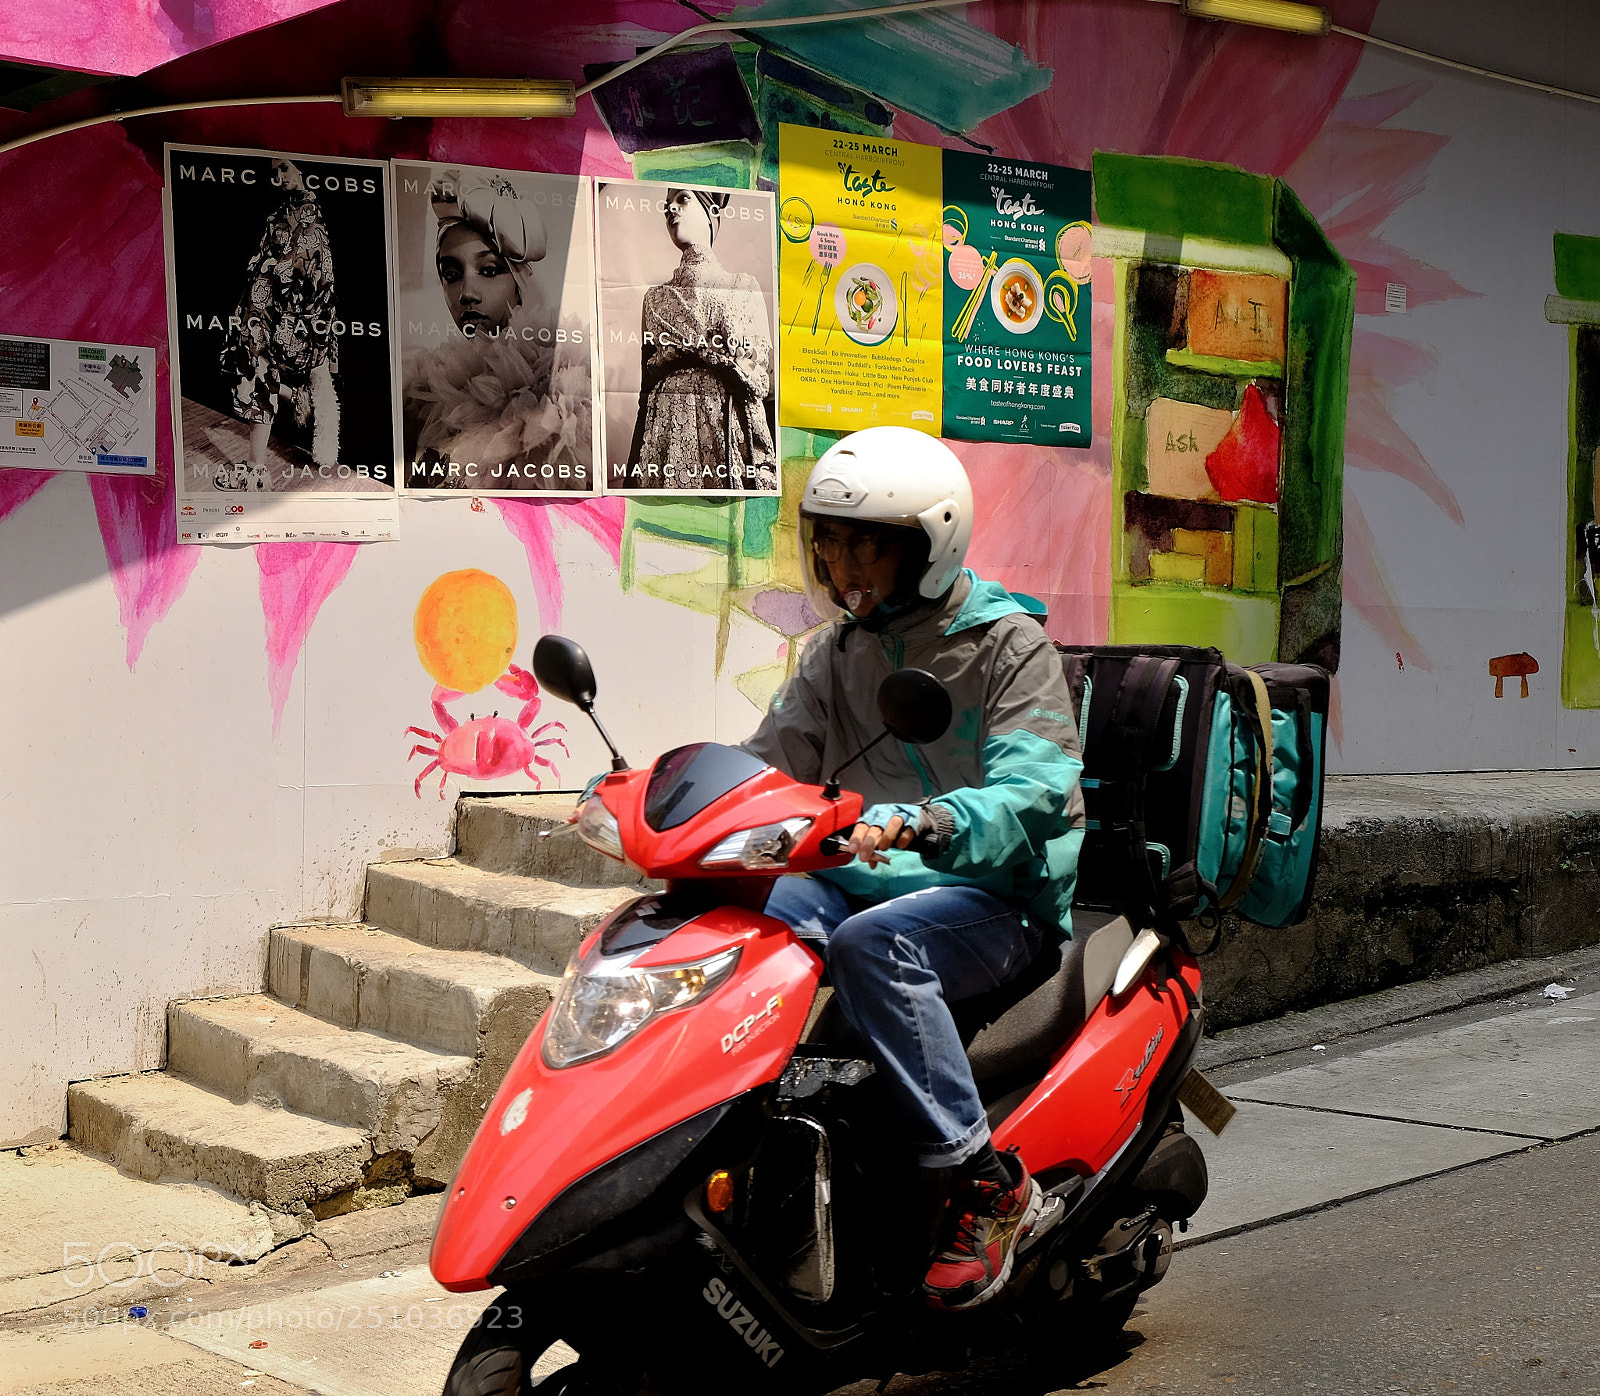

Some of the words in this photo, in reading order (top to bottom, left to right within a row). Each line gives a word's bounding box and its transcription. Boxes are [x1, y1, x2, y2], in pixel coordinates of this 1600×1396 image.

[832, 139, 860, 151] 22-25
[863, 143, 898, 157] MARCH
[824, 149, 854, 160] CENTRAL
[855, 154, 905, 168] HARBOURFRONT
[179, 165, 257, 185] MARC
[270, 174, 376, 195] JCOBS
[842, 162, 896, 198] taste
[980, 173, 1007, 184] CENTRAL
[1008, 177, 1055, 190] HARBOURFRONT
[987, 163, 1013, 175] 22-25
[1015, 167, 1048, 181] MARCH
[837, 197, 866, 207] HONG
[870, 202, 897, 212] KONG
[995, 188, 1045, 221] taste
[990, 218, 1017, 230] HONG
[1020, 222, 1046, 233] KONG
[408, 320, 476, 338] MARC
[488, 325, 583, 344] JACOBS
[610, 330, 672, 347] MARC
[964, 344, 1000, 356] WHERE
[1004, 348, 1035, 360] HONG
[1038, 352, 1075, 363] KONG'S
[957, 355, 992, 369] FOOD
[997, 359, 1043, 374] LOVERS
[1047, 364, 1082, 377] FEAST
[966, 376, 1075, 400] 美食同好者年度盛典
[990, 400, 1046, 411] tasteofhongkong.com
[281, 464, 388, 480] JACOBS
[411, 461, 478, 478] MARC
[491, 462, 587, 480] JACOBS
[613, 464, 676, 480] MARC
[702, 1277, 785, 1369] SUZUKI
